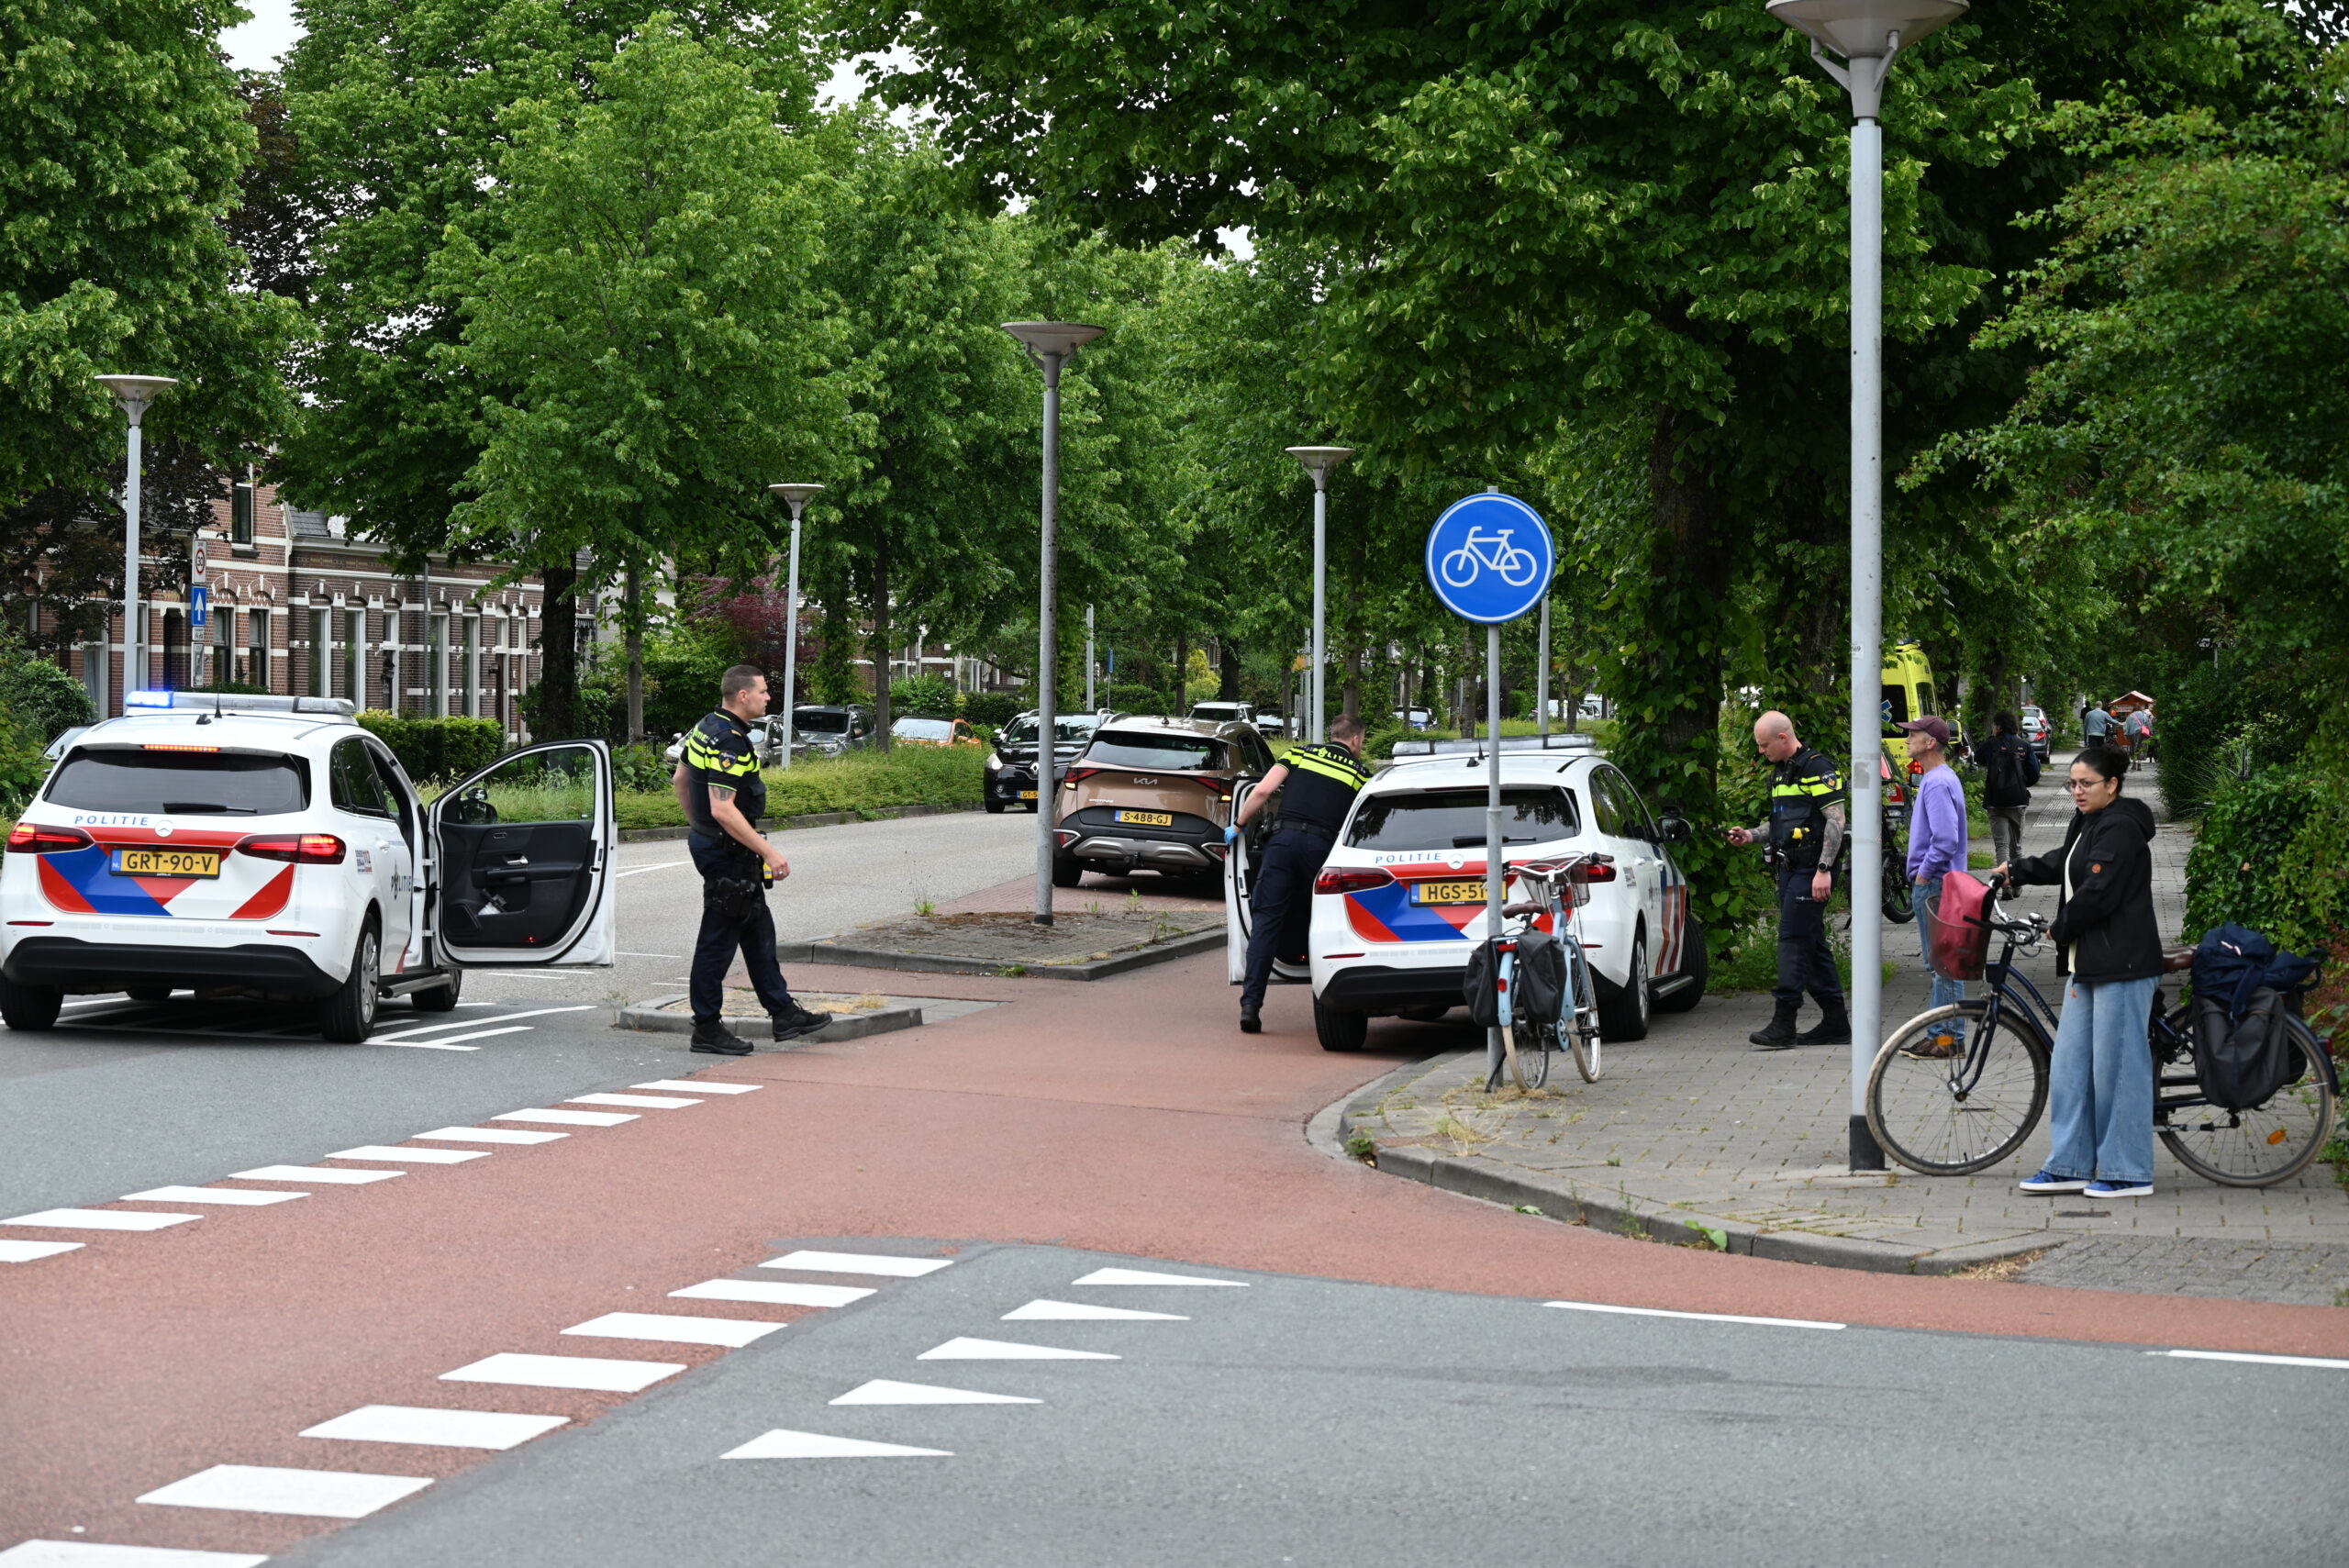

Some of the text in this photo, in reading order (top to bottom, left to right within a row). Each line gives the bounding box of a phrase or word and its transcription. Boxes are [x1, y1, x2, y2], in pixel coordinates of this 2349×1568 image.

[197, 556, 204, 567] 30
[1312, 747, 1355, 766] POLITIE
[74, 816, 150, 827] POLITIE
[1123, 811, 1169, 825] S-488-GJ
[127, 853, 213, 873] GRT-90-V
[1375, 852, 1442, 864] POLITIE
